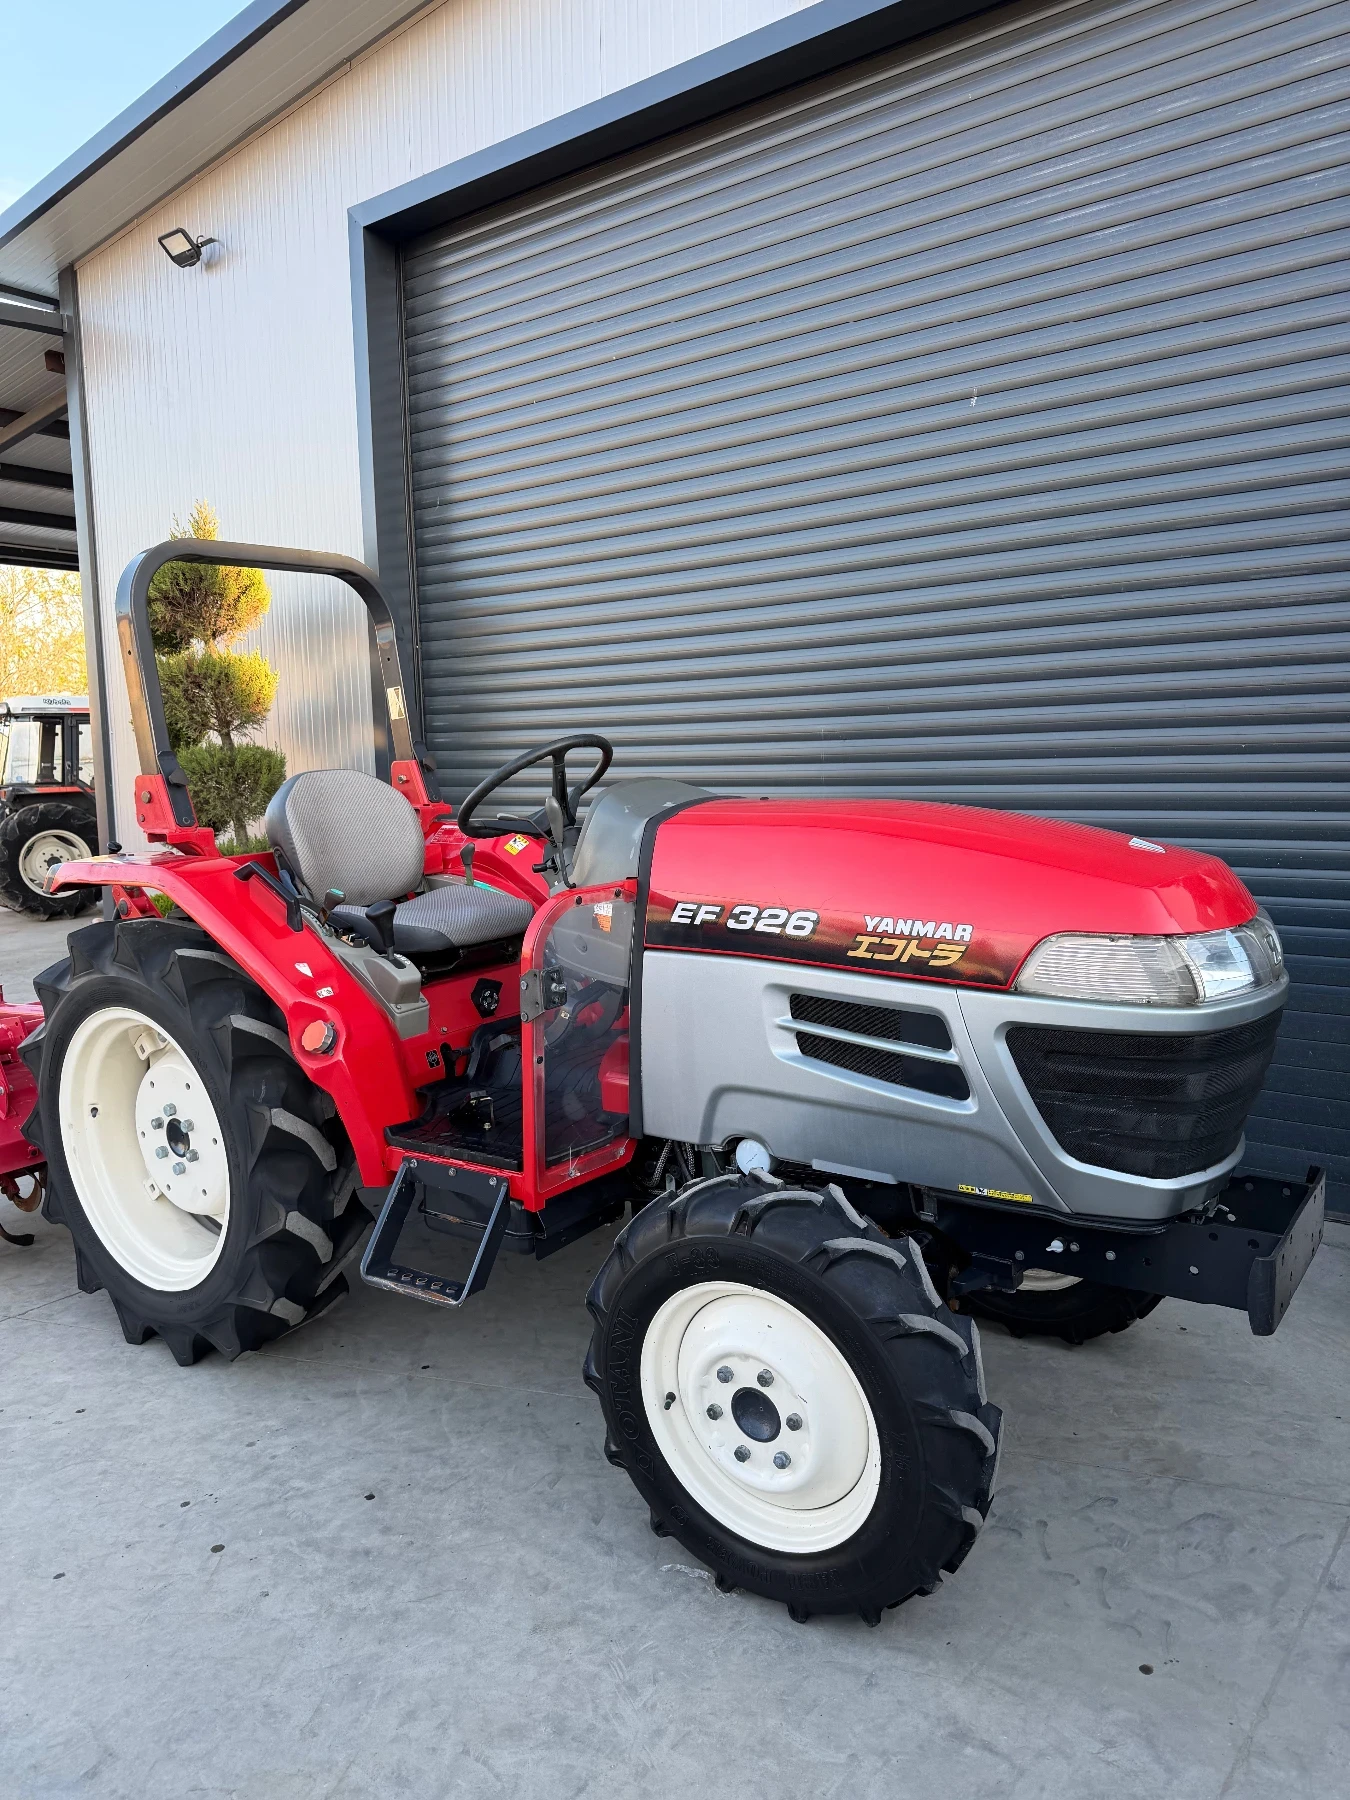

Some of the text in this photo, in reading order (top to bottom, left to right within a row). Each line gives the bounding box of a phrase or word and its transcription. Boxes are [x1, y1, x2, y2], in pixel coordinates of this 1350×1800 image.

[671, 903, 818, 937] EF 326
[865, 915, 974, 942] YANMAR
[847, 935, 967, 966] エコトラ
[607, 1305, 640, 1441] OTANI
